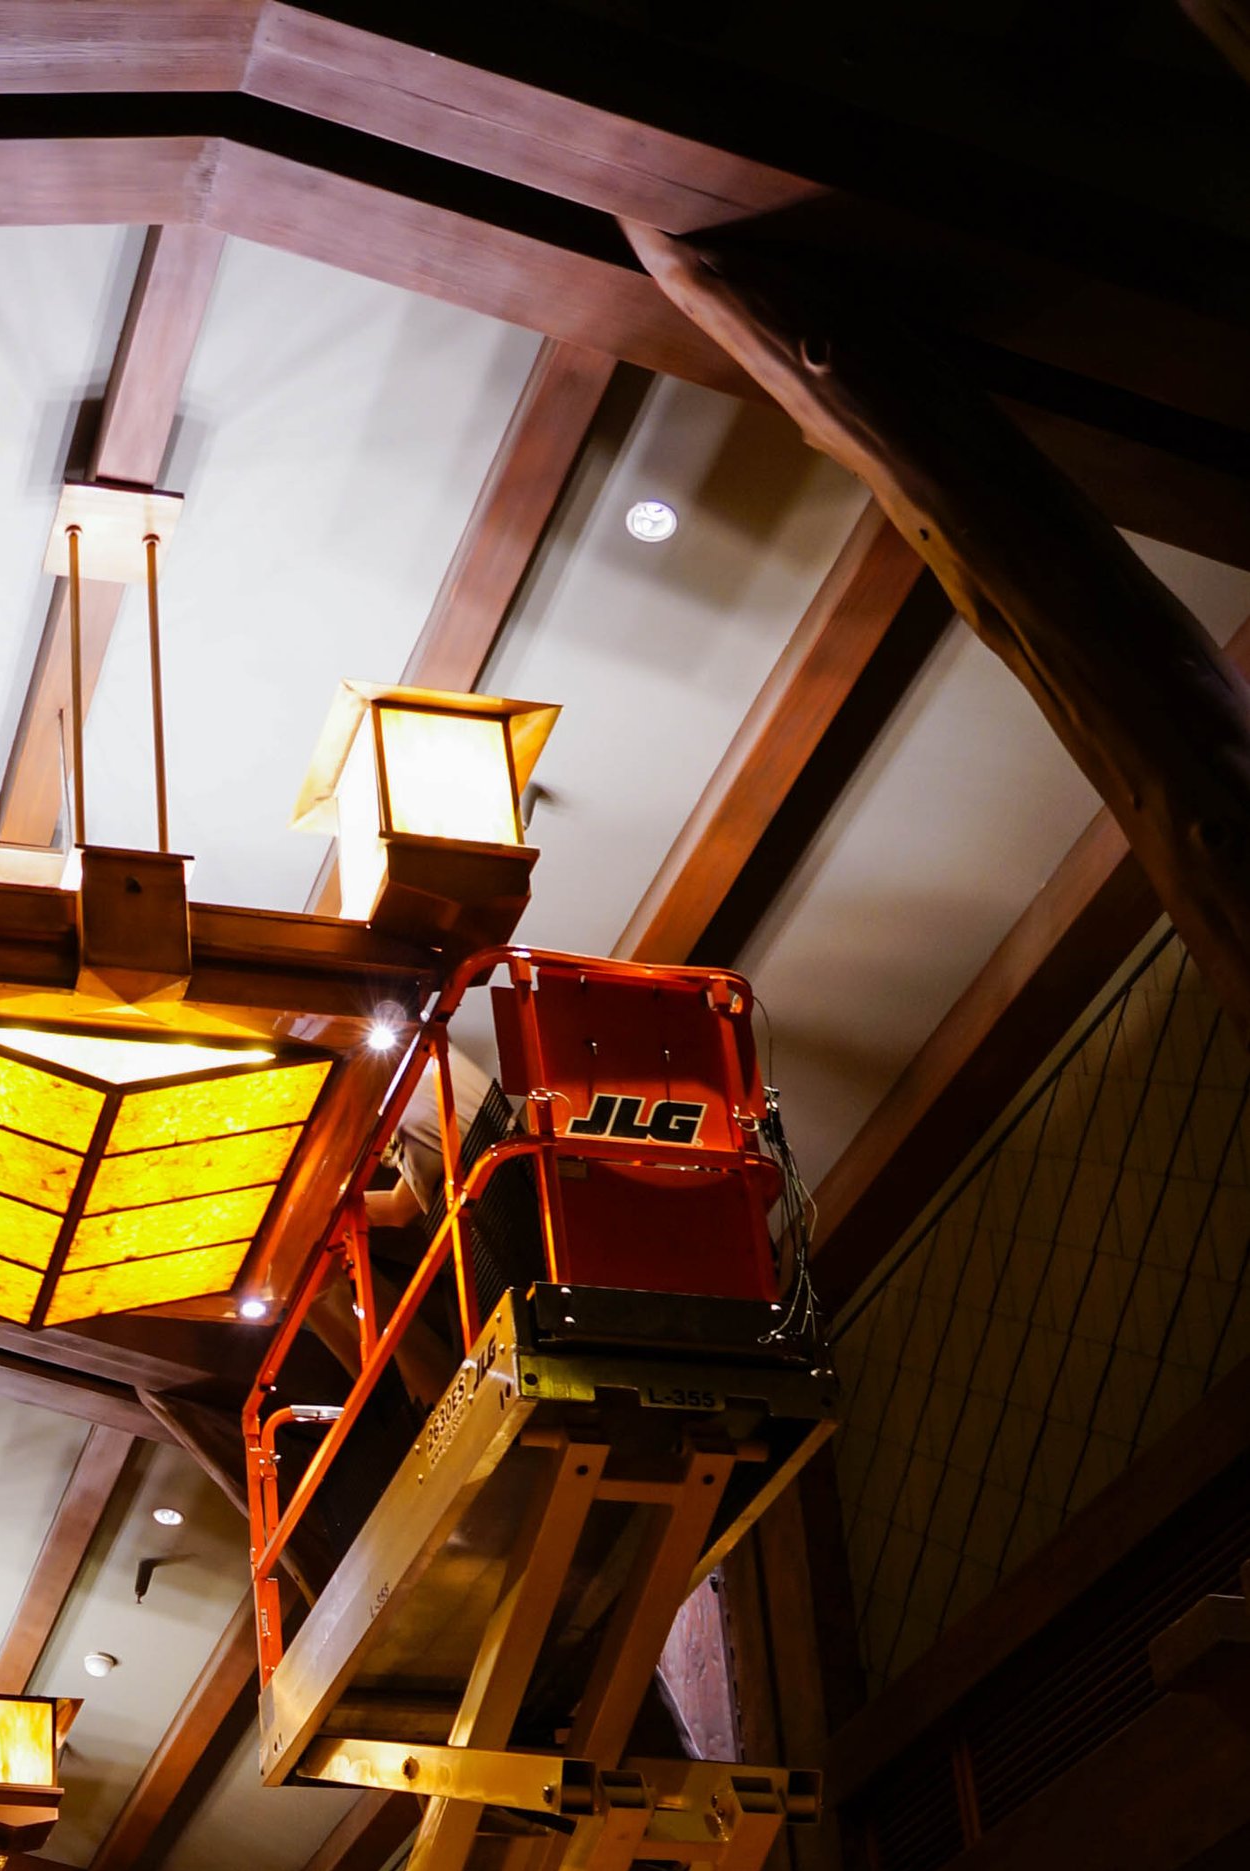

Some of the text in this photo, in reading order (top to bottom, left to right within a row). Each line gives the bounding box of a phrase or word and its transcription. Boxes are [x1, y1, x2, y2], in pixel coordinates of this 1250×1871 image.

[566, 1093, 707, 1146] JLG
[472, 1334, 497, 1393] JLG
[426, 1372, 466, 1459] 2630ES
[648, 1387, 715, 1408] L-355
